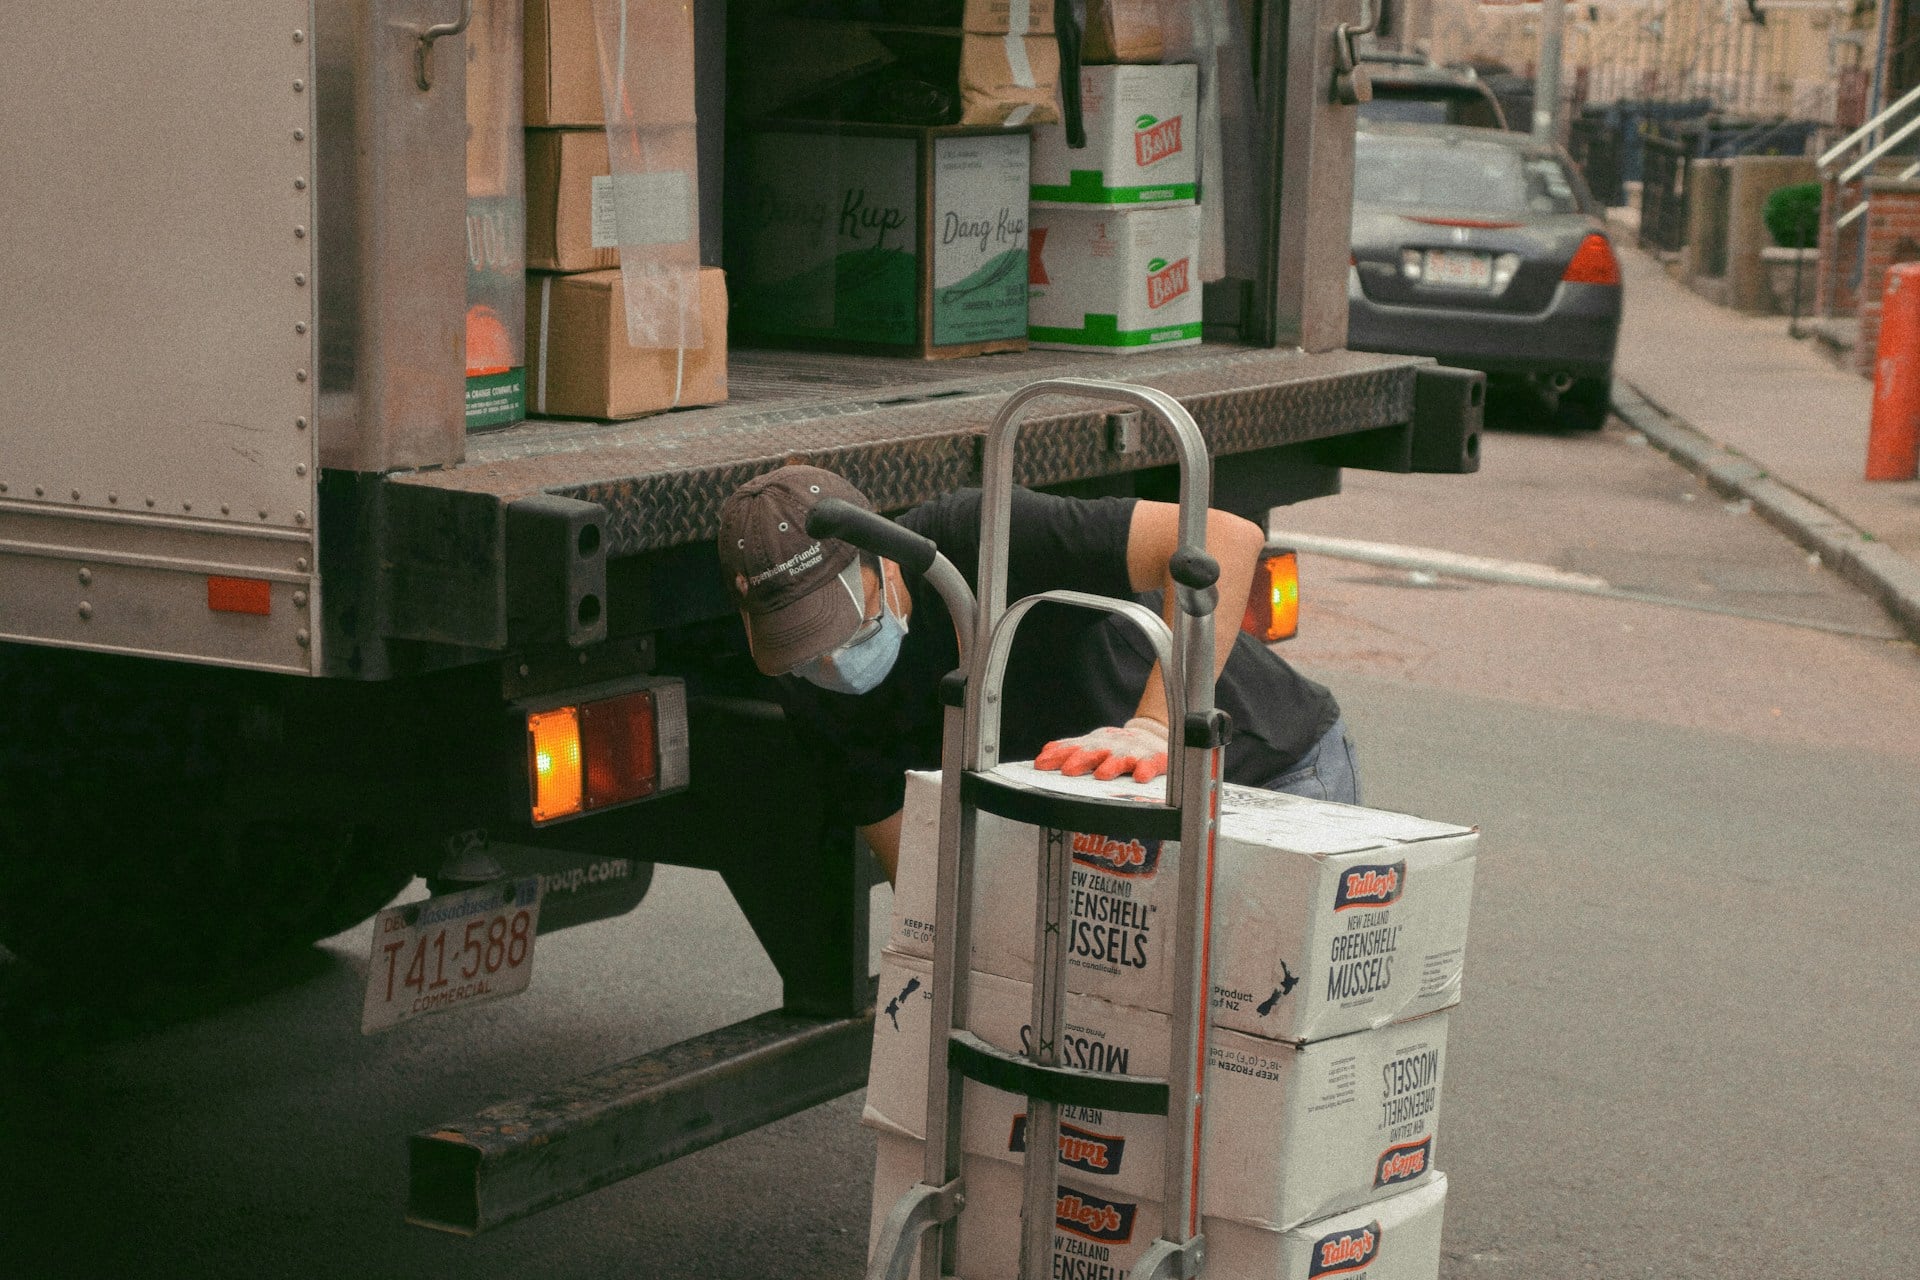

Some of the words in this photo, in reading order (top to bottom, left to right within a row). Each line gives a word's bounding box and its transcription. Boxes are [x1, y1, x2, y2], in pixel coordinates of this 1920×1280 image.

[1141, 121, 1178, 163] B&W
[838, 188, 908, 249] Kup
[942, 211, 992, 253] Dang
[996, 207, 1026, 250] Kup
[1151, 262, 1187, 305] B&W
[789, 554, 823, 577] Rochester
[1089, 874, 1133, 898] ZEALAND
[1346, 868, 1398, 899] Talley's
[904, 917, 923, 930] KEEP
[1347, 914, 1362, 931] NEW
[1362, 910, 1390, 929] ZEALAND
[1327, 955, 1394, 1001] MUSSELS
[412, 980, 492, 1014] COMMERCIAL
[1212, 998, 1224, 1008] of
[1225, 1000, 1240, 1012] NZ
[1214, 986, 1254, 1003] Product
[1225, 1051, 1235, 1060] or
[1218, 1060, 1254, 1076] FROZEN
[1255, 1069, 1279, 1082] KEEP
[1383, 1048, 1438, 1099] MUSSELS
[1390, 1122, 1413, 1143] ZEALAND
[1412, 1118, 1425, 1135] NEW
[1381, 1148, 1425, 1183] Talley's
[1065, 1238, 1110, 1262] ZEALAND
[1321, 1229, 1375, 1267] Talley's
